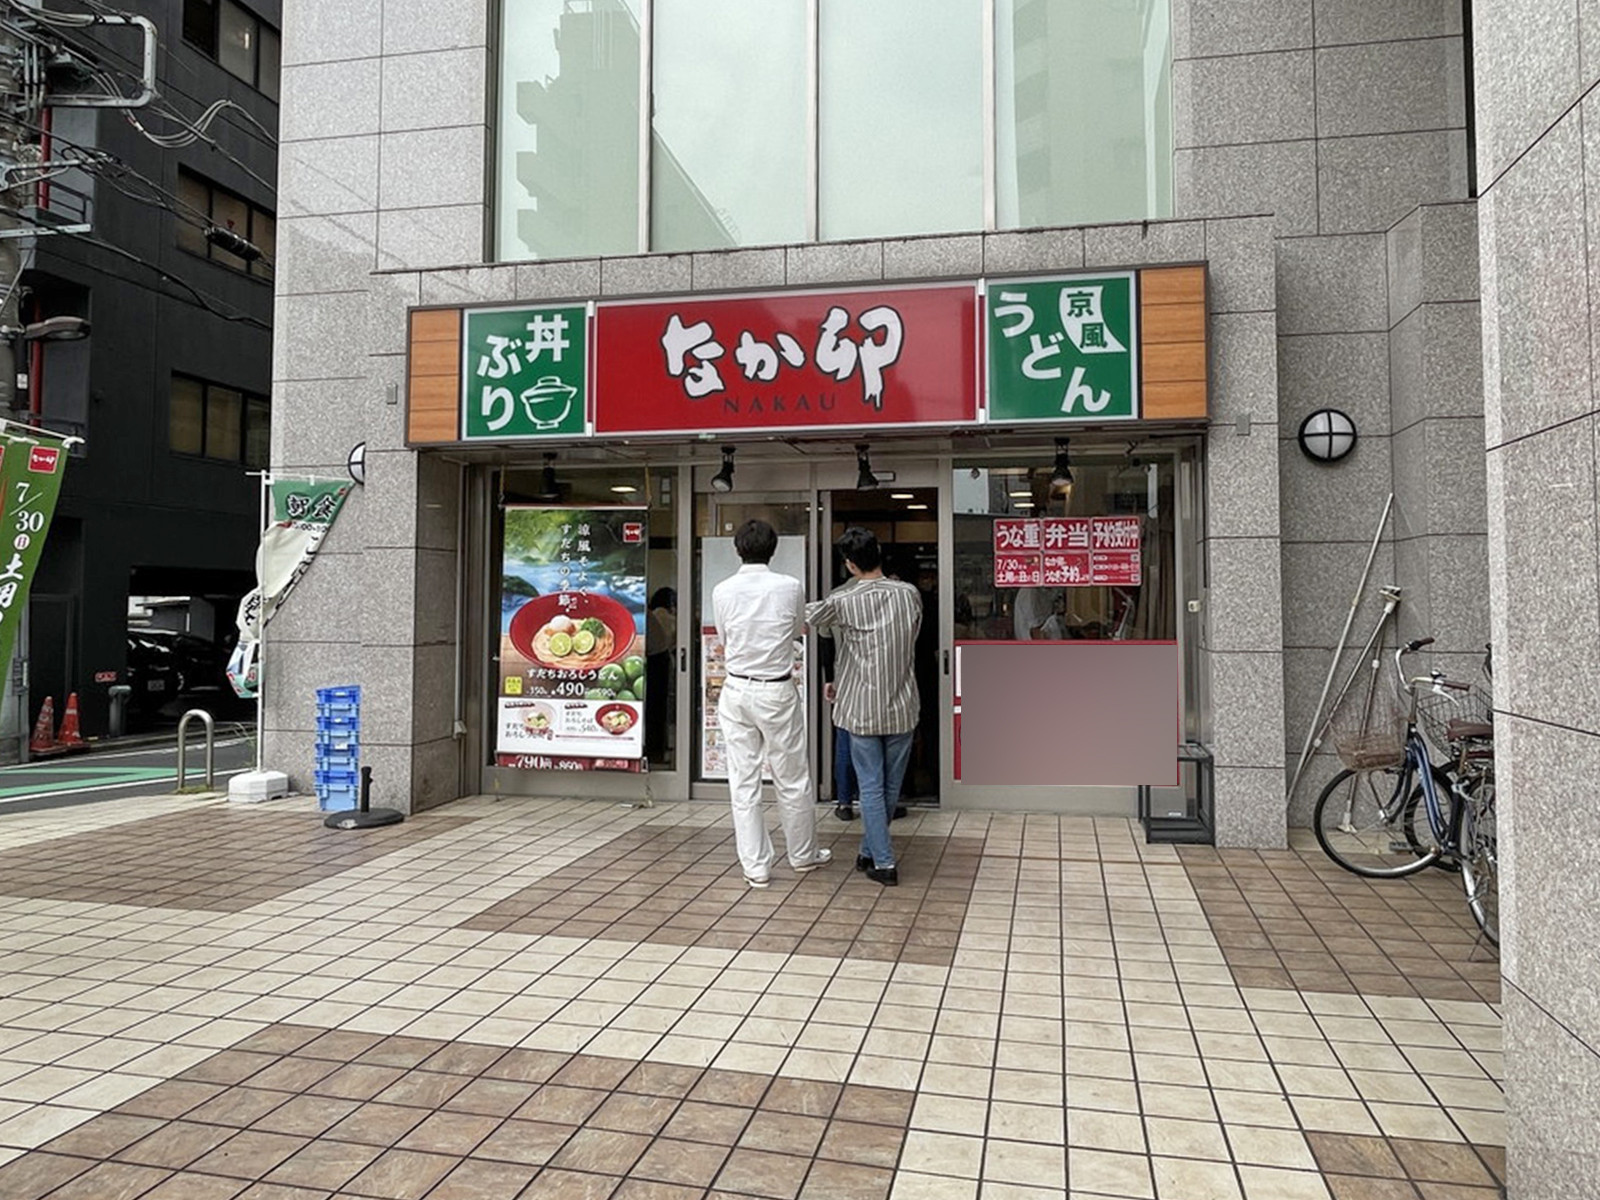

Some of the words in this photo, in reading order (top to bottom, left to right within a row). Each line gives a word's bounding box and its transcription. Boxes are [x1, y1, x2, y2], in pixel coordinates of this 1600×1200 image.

[1066, 291, 1108, 349] 京風
[661, 306, 904, 410] なか卯
[994, 291, 1111, 413] うどん
[724, 393, 836, 413] NAKAU
[997, 523, 1040, 548] うな重
[1045, 523, 1088, 547] 弁当
